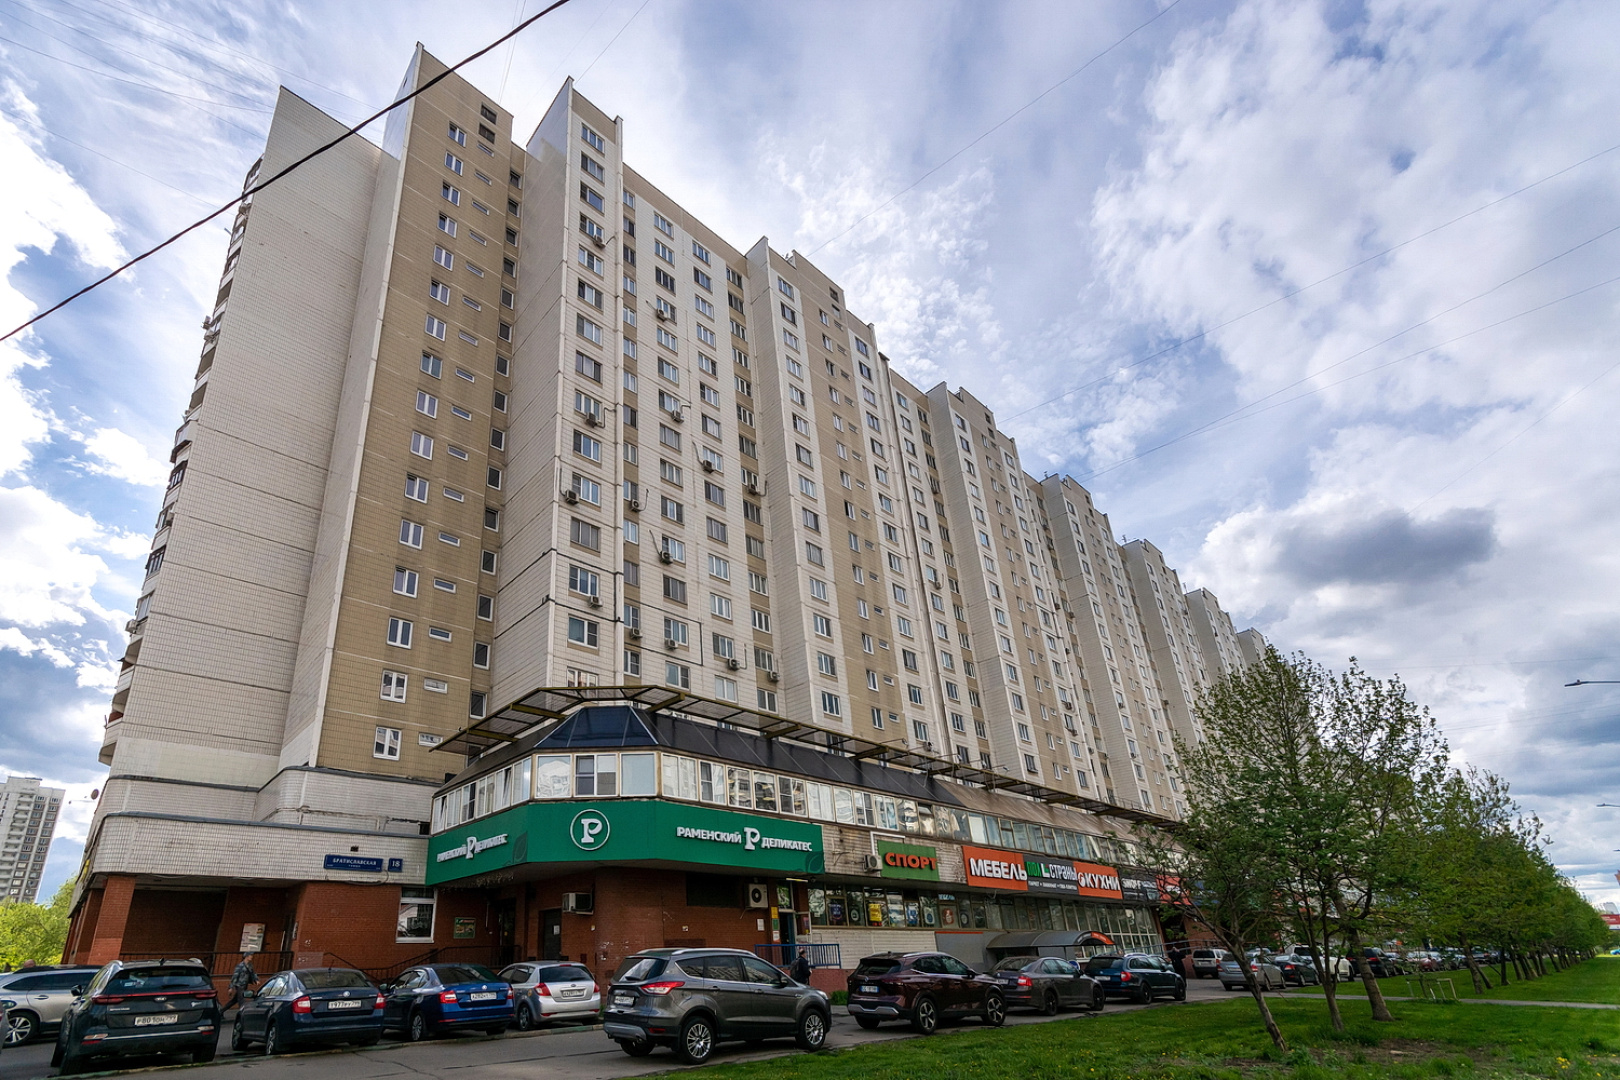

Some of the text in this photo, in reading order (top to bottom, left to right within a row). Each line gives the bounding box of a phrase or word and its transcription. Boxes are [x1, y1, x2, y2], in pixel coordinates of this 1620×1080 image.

[676, 826, 742, 843] РАМЕНСКИЙ
[761, 837, 812, 852] ДЕЛИКАТЕС
[332, 857, 377, 866] БРАТИСЛАВСКАЯ
[391, 860, 400, 868] 18
[885, 852, 937, 870] СПОРТ
[969, 857, 1028, 881] МЕБЕЛЬ
[1084, 872, 1121, 891] КУХНИ
